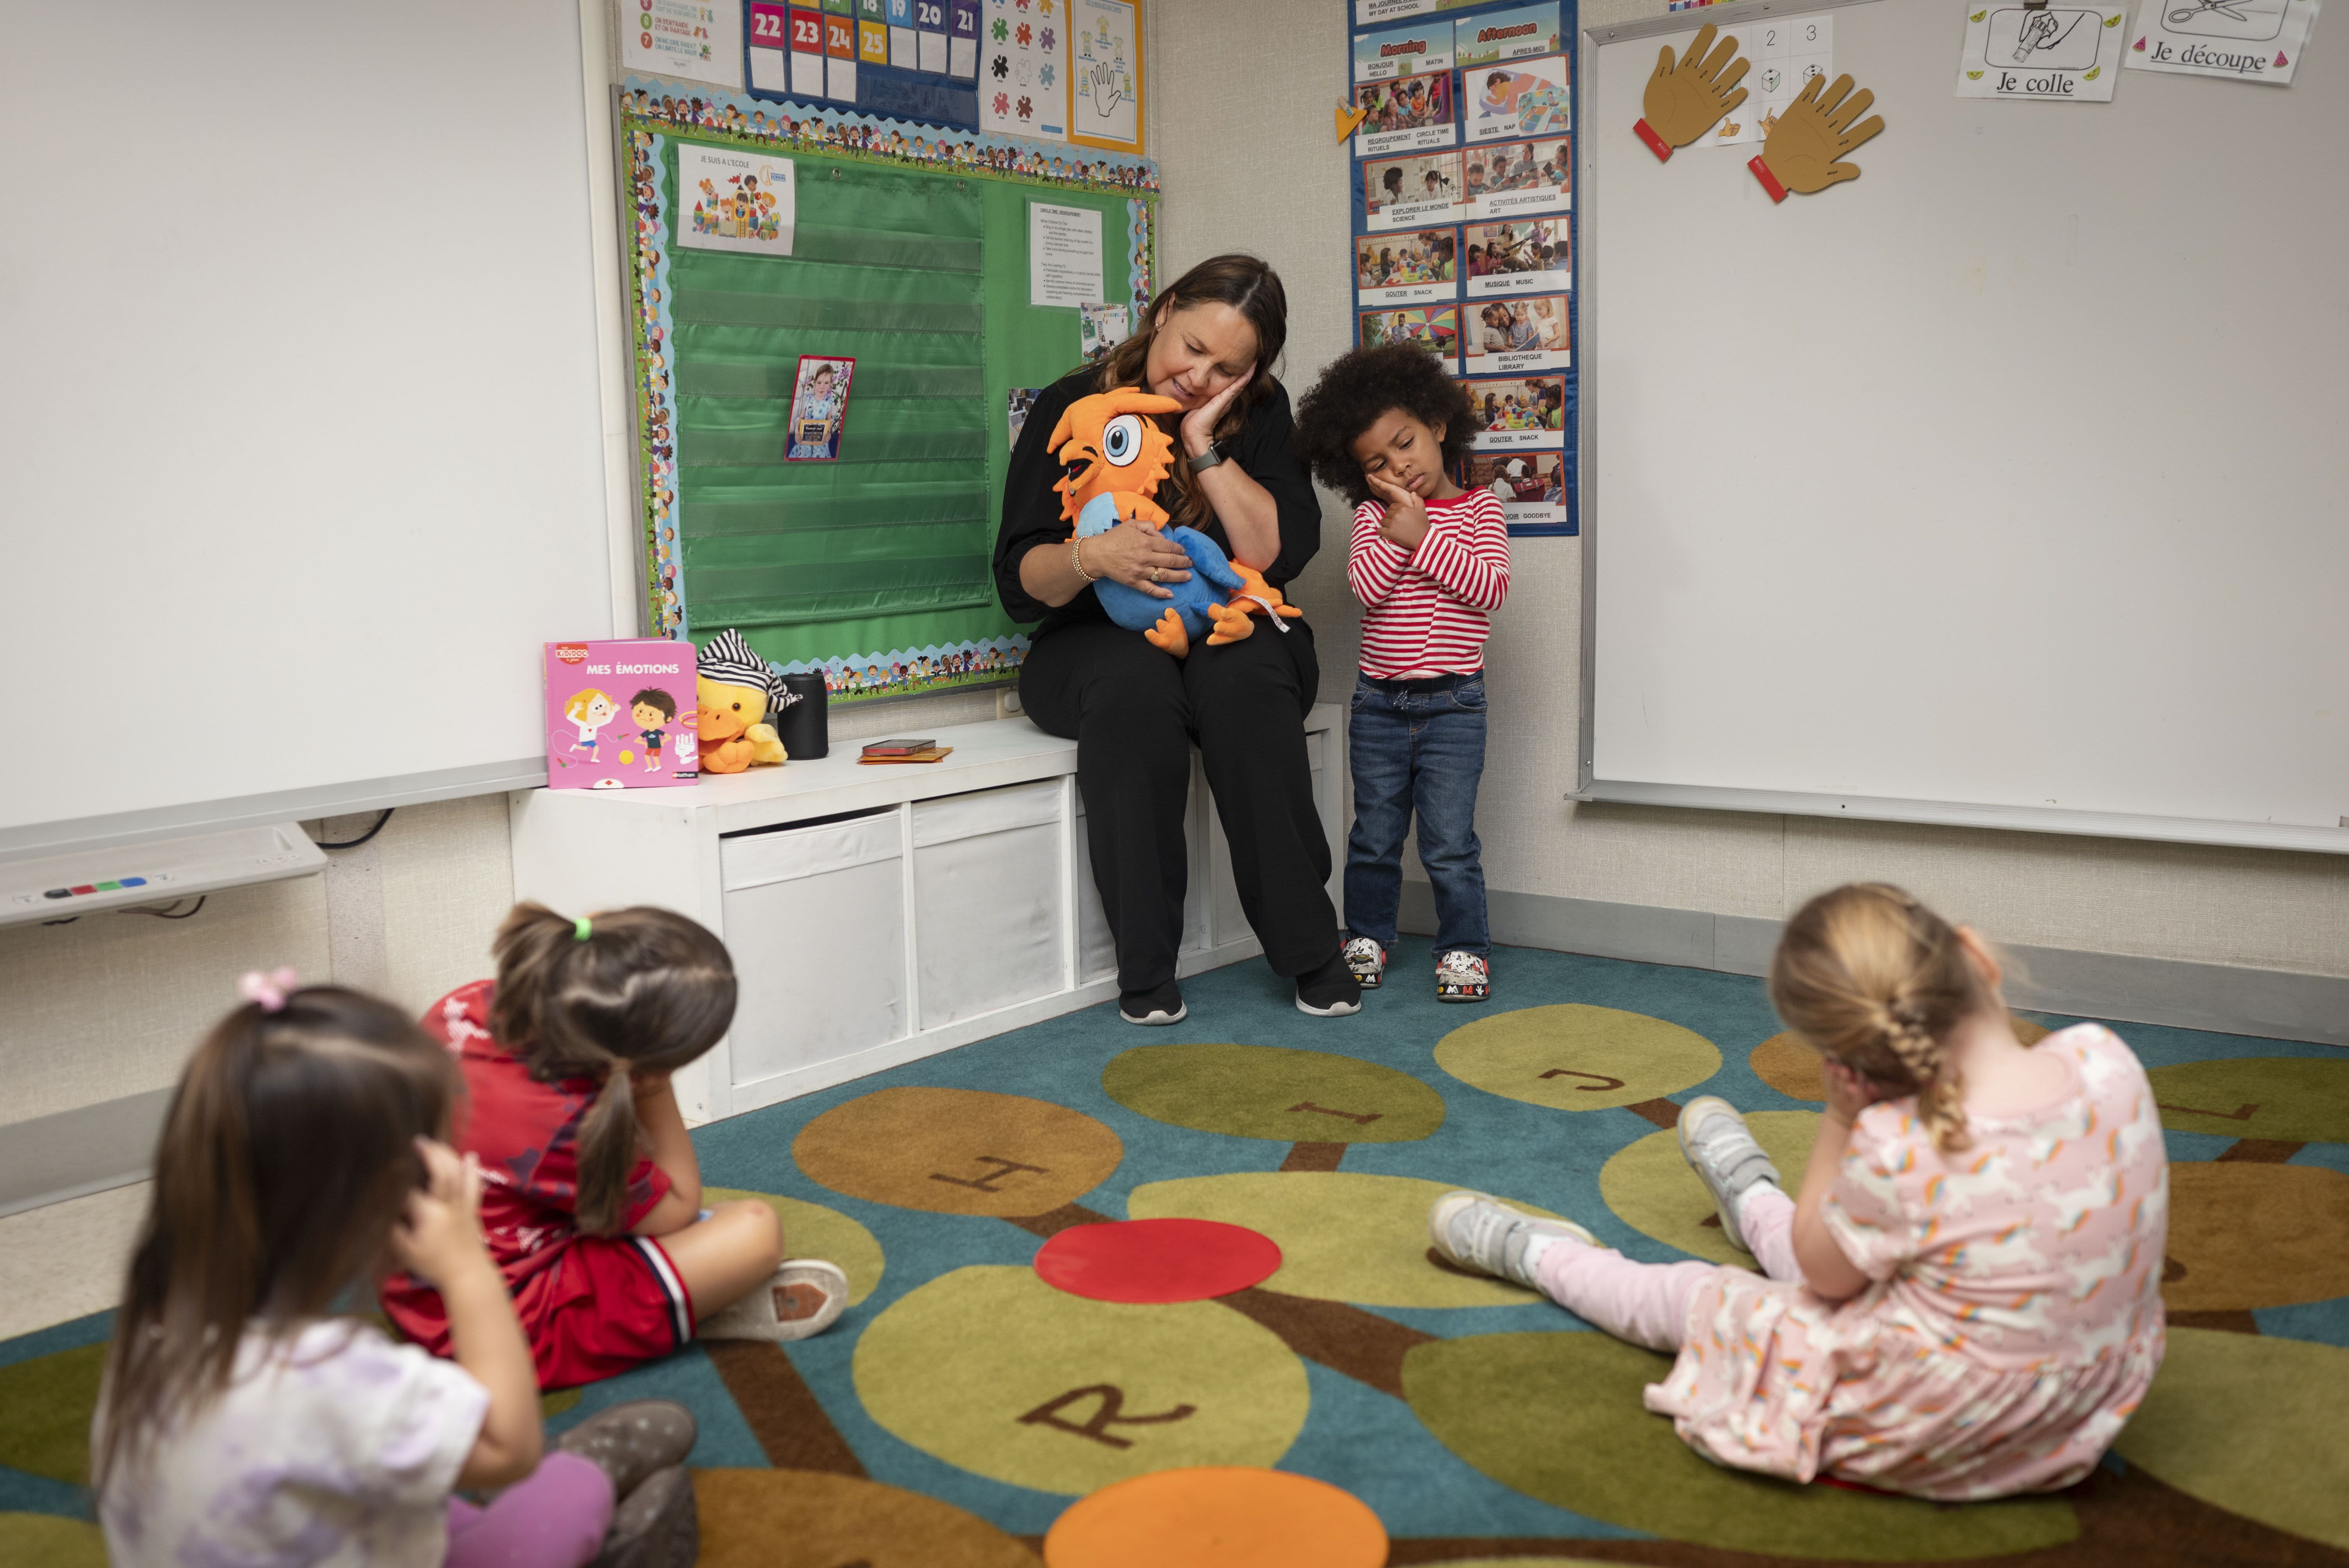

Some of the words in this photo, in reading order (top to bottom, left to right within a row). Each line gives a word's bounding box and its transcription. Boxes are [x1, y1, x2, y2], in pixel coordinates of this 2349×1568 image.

[1397, 3, 1419, 11] SCHOOL
[644, 16, 649, 25] 6
[892, 0, 905, 18] 19
[918, 2, 941, 25] 20
[957, 9, 973, 32] 21
[670, 27, 691, 36] PARTAGE
[755, 13, 781, 37] 22
[795, 20, 819, 43] 23
[829, 25, 850, 49] 24
[864, 31, 883, 54] 25
[1477, 23, 1537, 43] Afternoon
[1767, 30, 1775, 46] 2
[1807, 25, 1816, 41] 3
[644, 36, 649, 45] 7
[1380, 40, 1427, 57] Morning
[1513, 46, 1545, 55] APRES-MIDI
[2150, 41, 2172, 61] Je
[2181, 44, 2266, 74] découpe
[1368, 61, 1394, 69] BONJOUR
[1997, 72, 2016, 91] Je
[2026, 74, 2074, 93] colle
[1368, 134, 1411, 144] REGROUPEMENT
[708, 156, 720, 164] SUIS
[727, 159, 749, 168] L'ECOLE
[1490, 198, 1518, 206] ACTIVITÉS
[1519, 194, 1556, 203] ARTISTIQUES
[1392, 206, 1420, 214] EXPLORER
[586, 665, 611, 675] MES
[616, 661, 679, 674] ÉMOTIONS
[1538, 1069, 1625, 1091] J
[927, 1155, 1050, 1193] H
[1017, 1383, 1198, 1450] R
